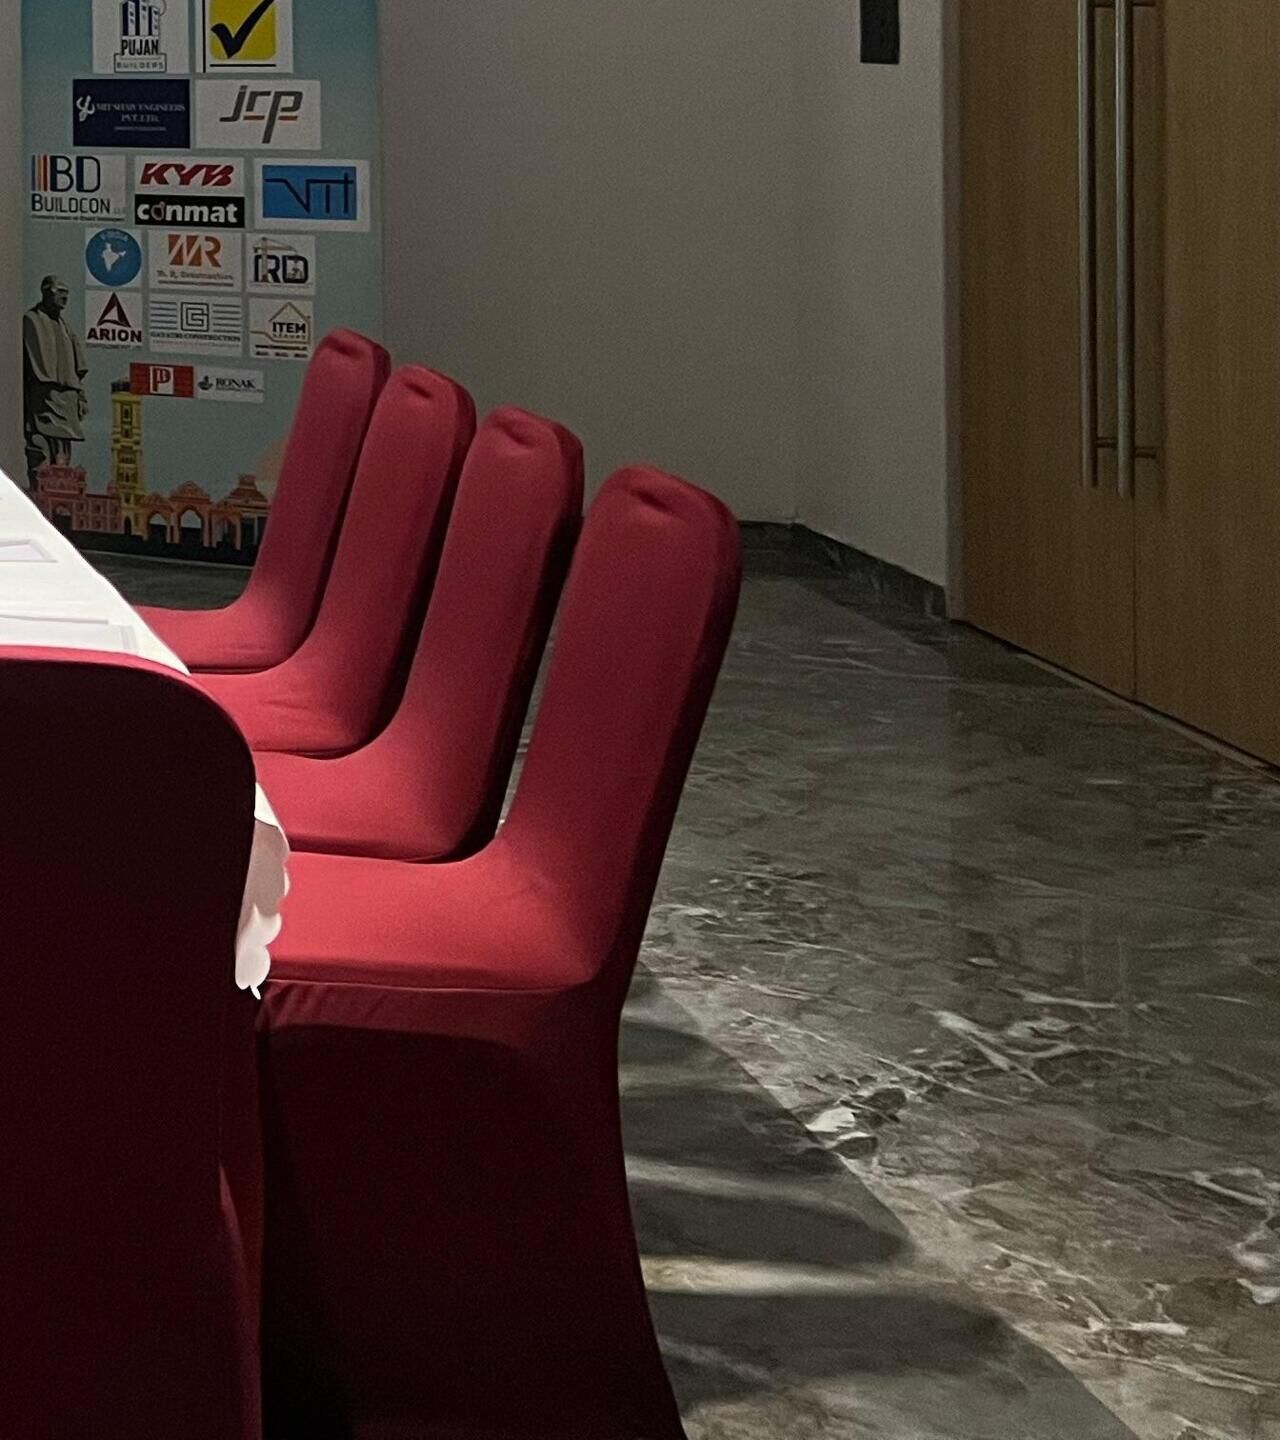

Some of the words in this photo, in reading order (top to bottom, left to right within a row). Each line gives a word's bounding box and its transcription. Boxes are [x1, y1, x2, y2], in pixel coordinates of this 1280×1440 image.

[121, 38, 160, 56] PUJAN
[116, 61, 164, 70] BUILDERS
[140, 163, 235, 187] KYB
[136, 200, 239, 224] conmat
[87, 327, 142, 343] ARION
[273, 322, 306, 334] ITEM
[215, 377, 255, 389] RONAK
